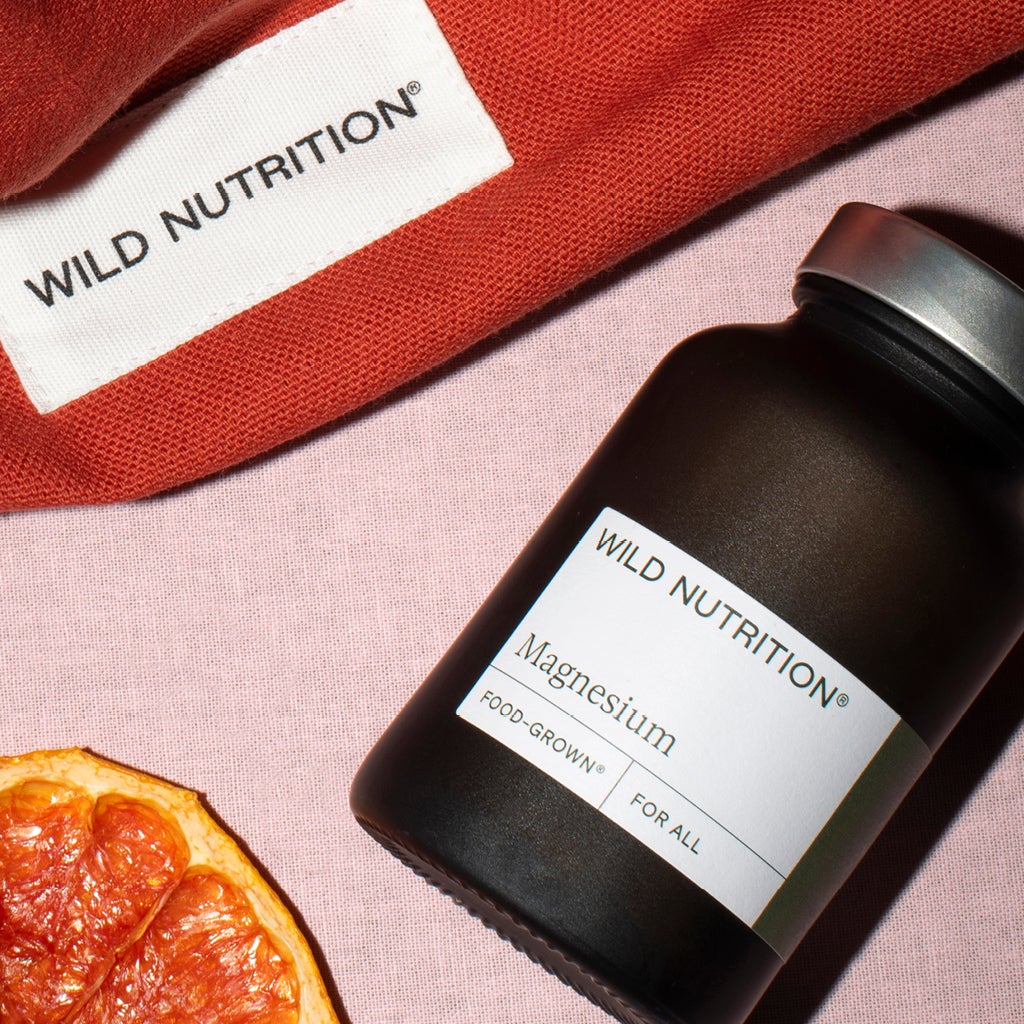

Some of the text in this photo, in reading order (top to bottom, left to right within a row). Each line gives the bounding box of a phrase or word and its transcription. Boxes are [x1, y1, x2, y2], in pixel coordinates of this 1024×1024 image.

[23, 229, 150, 308] WILD
[594, 527, 666, 583] WILD
[514, 633, 678, 758] Magnesium
[630, 792, 702, 855] FOR ALL
